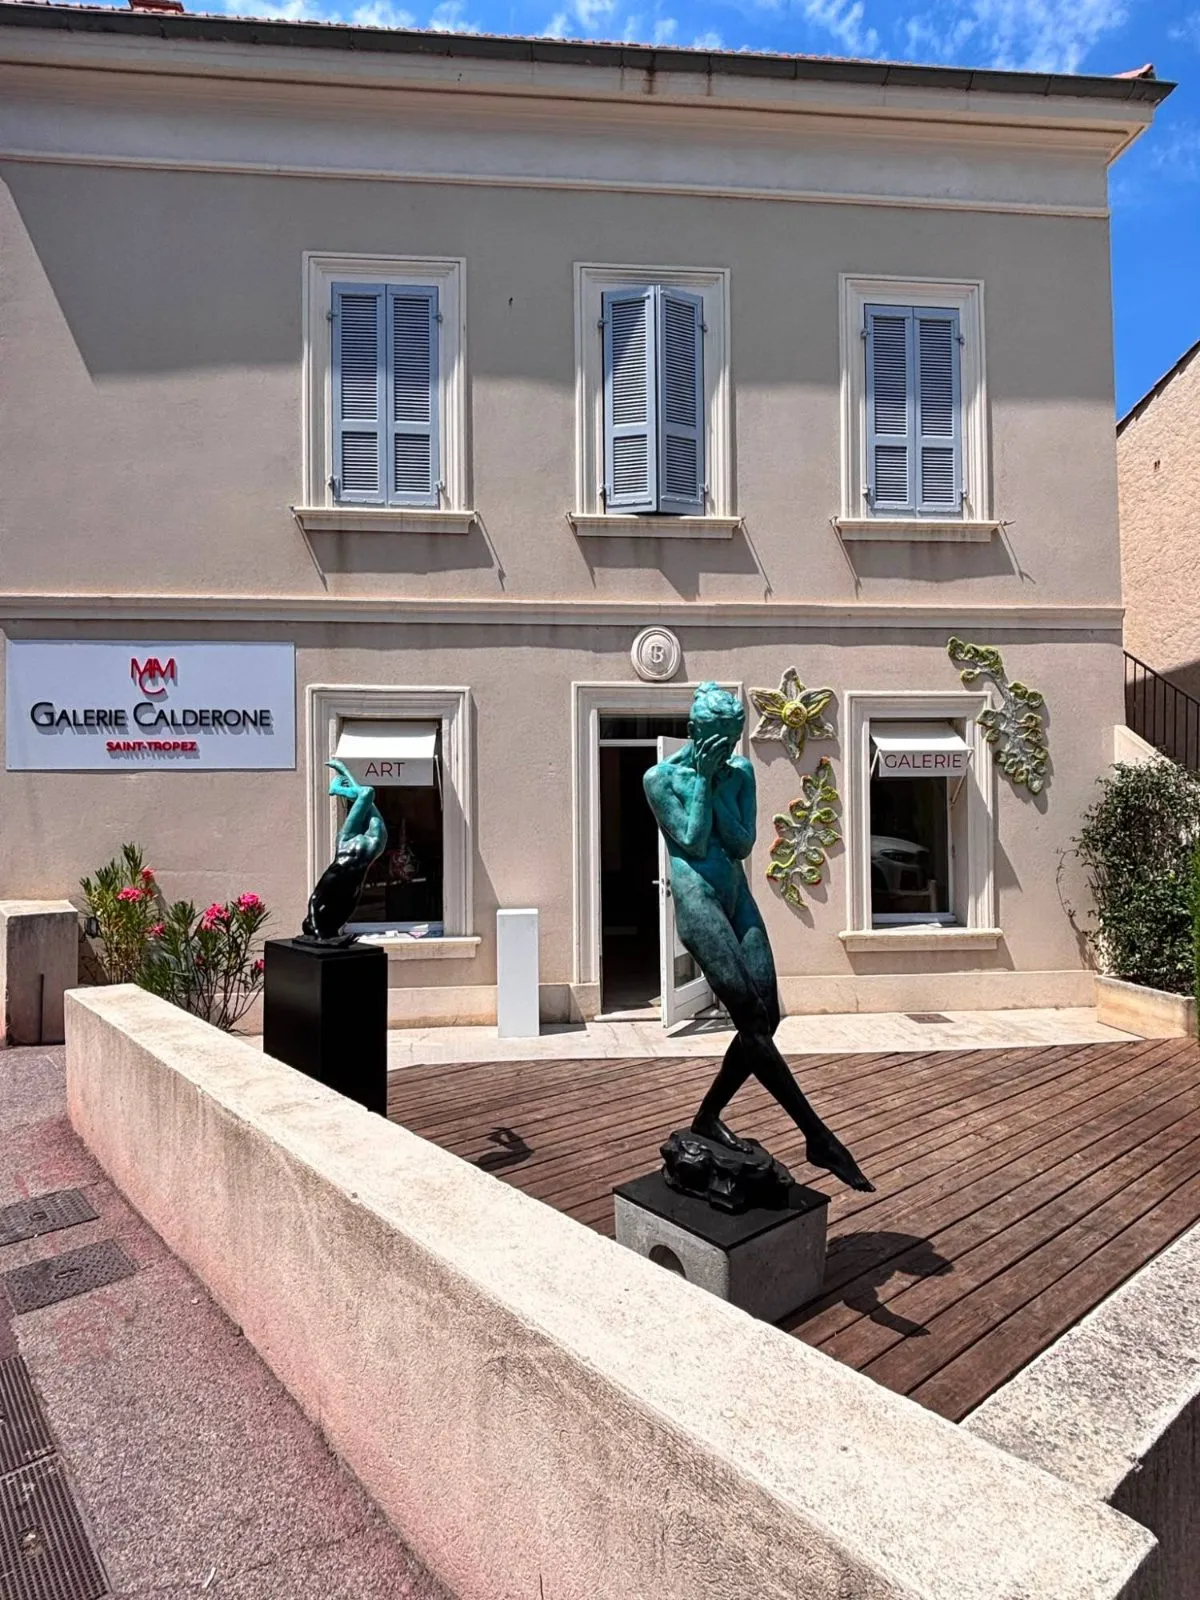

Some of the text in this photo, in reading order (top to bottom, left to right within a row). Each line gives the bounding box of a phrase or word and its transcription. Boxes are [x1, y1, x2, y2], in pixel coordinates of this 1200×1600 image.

[30, 702, 271, 727] GALERIE CALDERONE
[106, 741, 197, 752] SAINT-TROPEZ
[884, 754, 962, 768] GALERIE
[365, 762, 405, 777] ART
